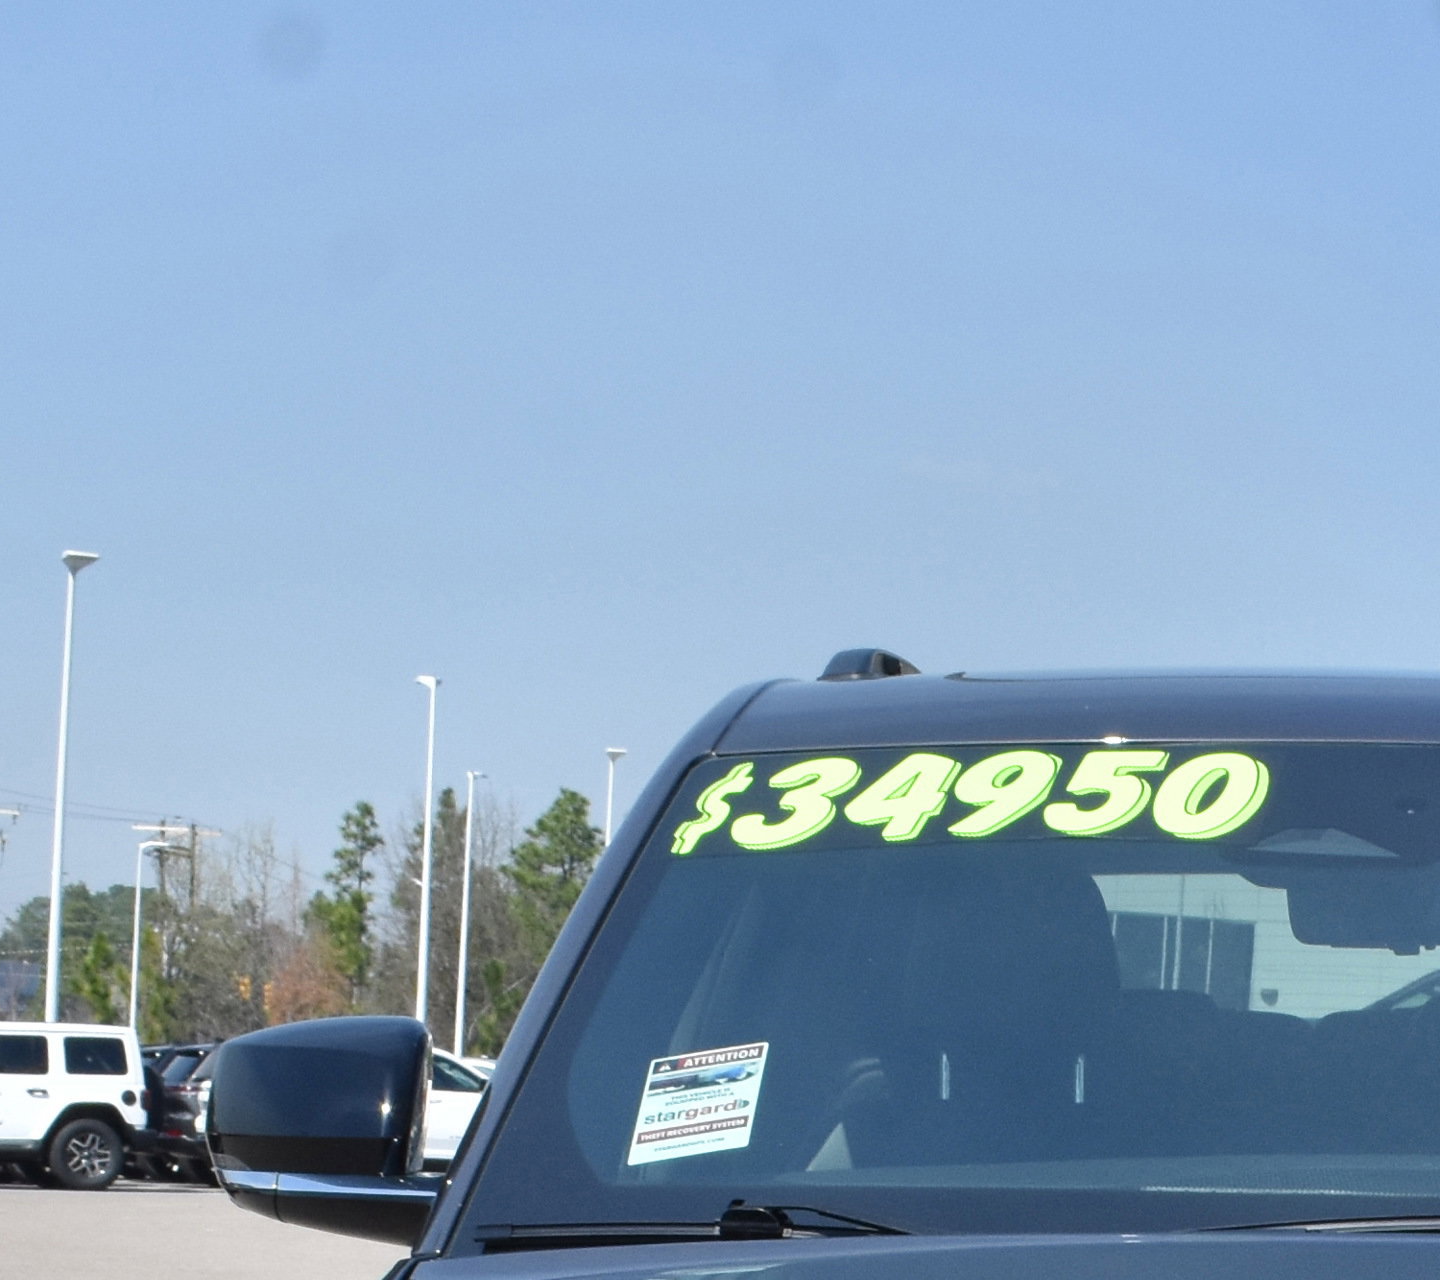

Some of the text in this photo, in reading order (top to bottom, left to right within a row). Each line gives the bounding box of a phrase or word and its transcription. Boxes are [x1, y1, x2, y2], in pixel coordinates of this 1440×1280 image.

[670, 750, 1270, 856] $34950
[683, 1048, 760, 1068] ATTENTION
[644, 1099, 738, 1125] stargard
[640, 1118, 745, 1142] THEFT RECOVERY SYSTEM
